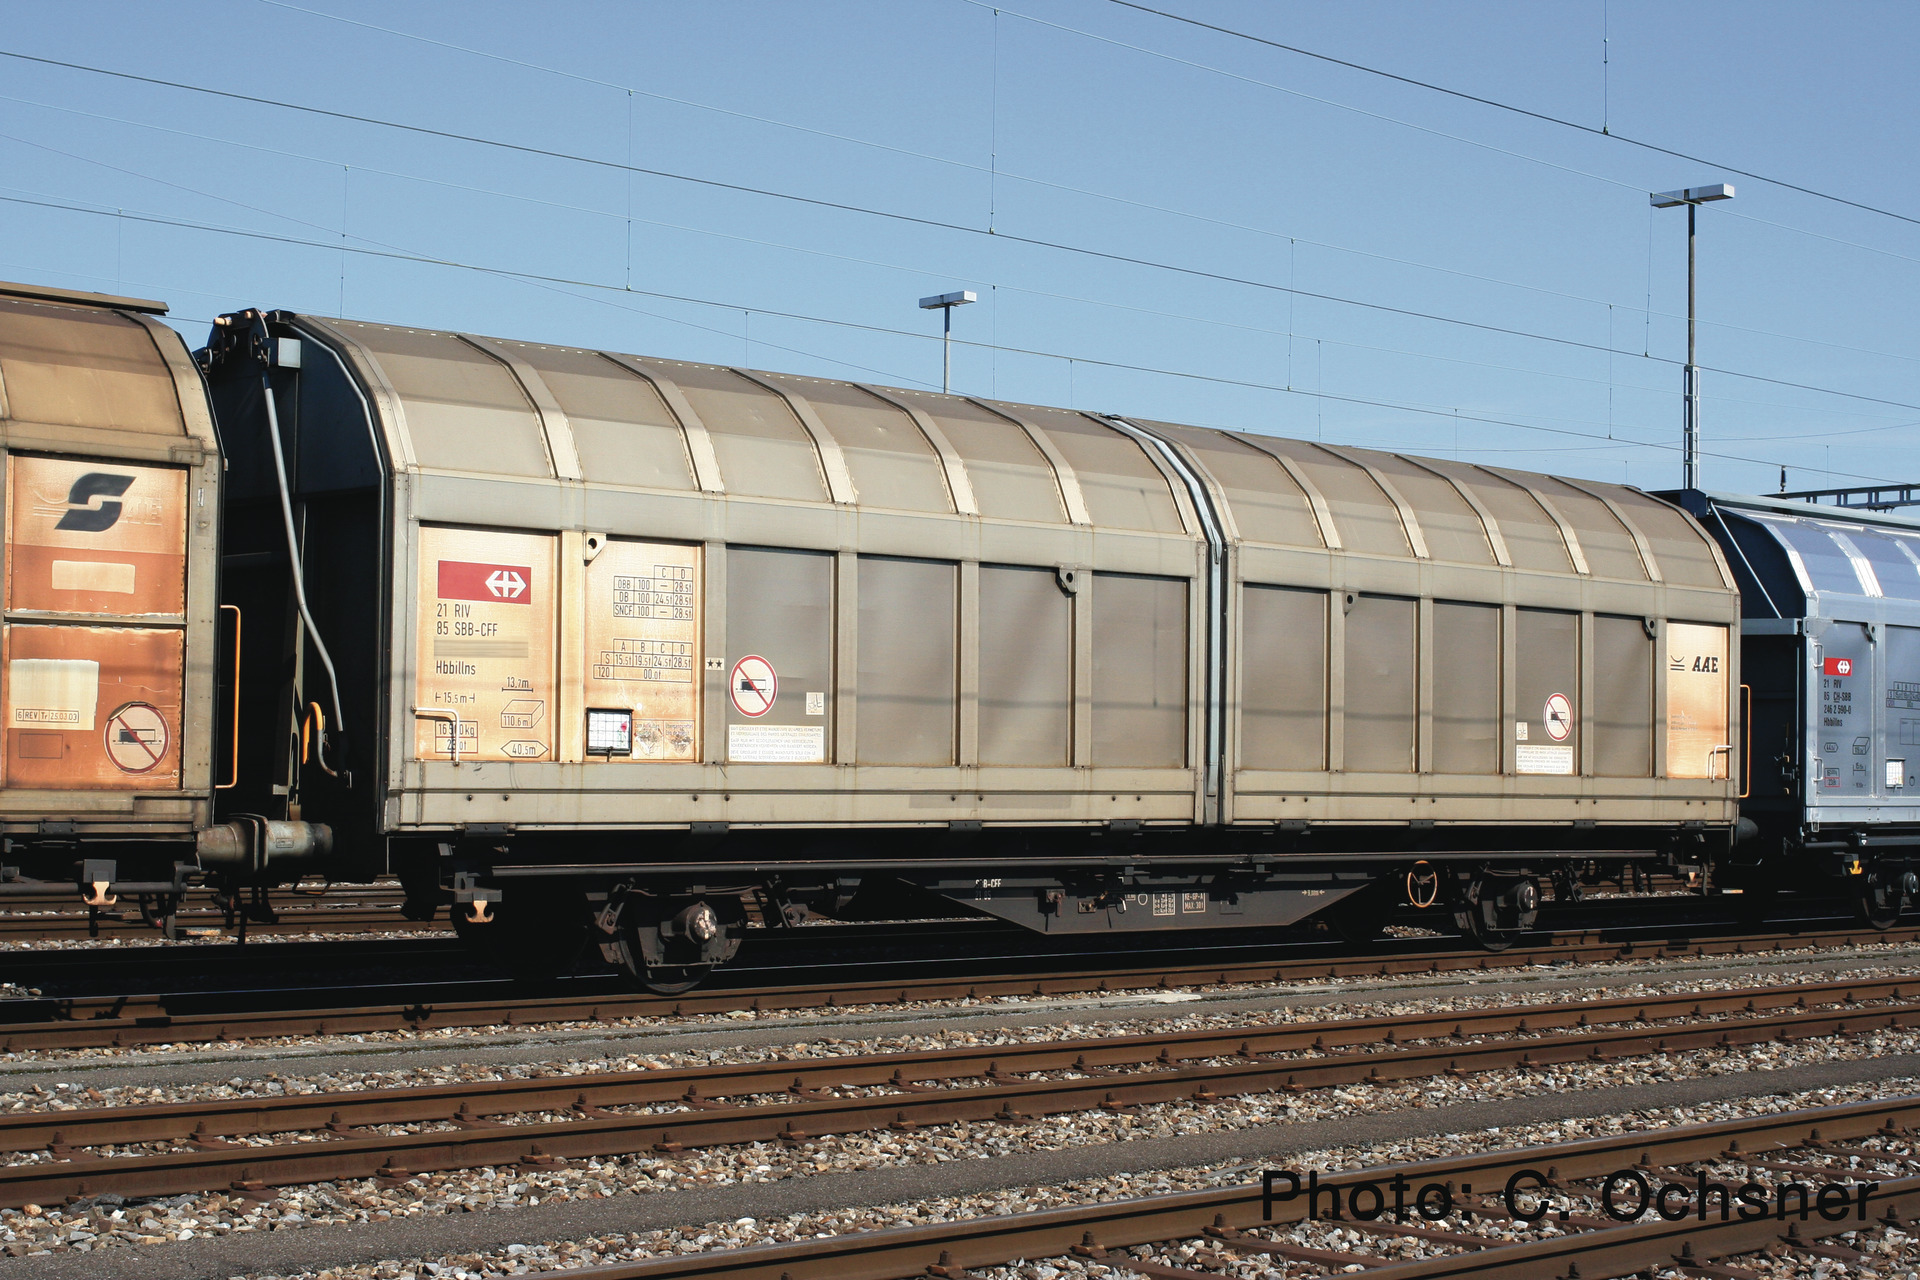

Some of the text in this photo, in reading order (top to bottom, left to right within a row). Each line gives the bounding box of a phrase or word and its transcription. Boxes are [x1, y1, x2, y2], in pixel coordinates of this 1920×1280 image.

[662, 568, 666, 578] C
[638, 580, 650, 590] 100
[619, 592, 628, 602] DB
[638, 592, 650, 604] 100
[437, 602, 470, 618] 21 RIV
[614, 604, 632, 616] SNCF
[638, 606, 650, 616] 100
[437, 621, 498, 636] 85 SBB-CFF
[621, 641, 626, 652] A
[641, 642, 645, 652] B
[660, 643, 665, 654] C
[606, 654, 610, 664] S
[1692, 656, 1718, 672] AAE
[436, 660, 476, 675] Hbbillns
[598, 666, 610, 678] 120
[25, 712, 38, 720] REV
